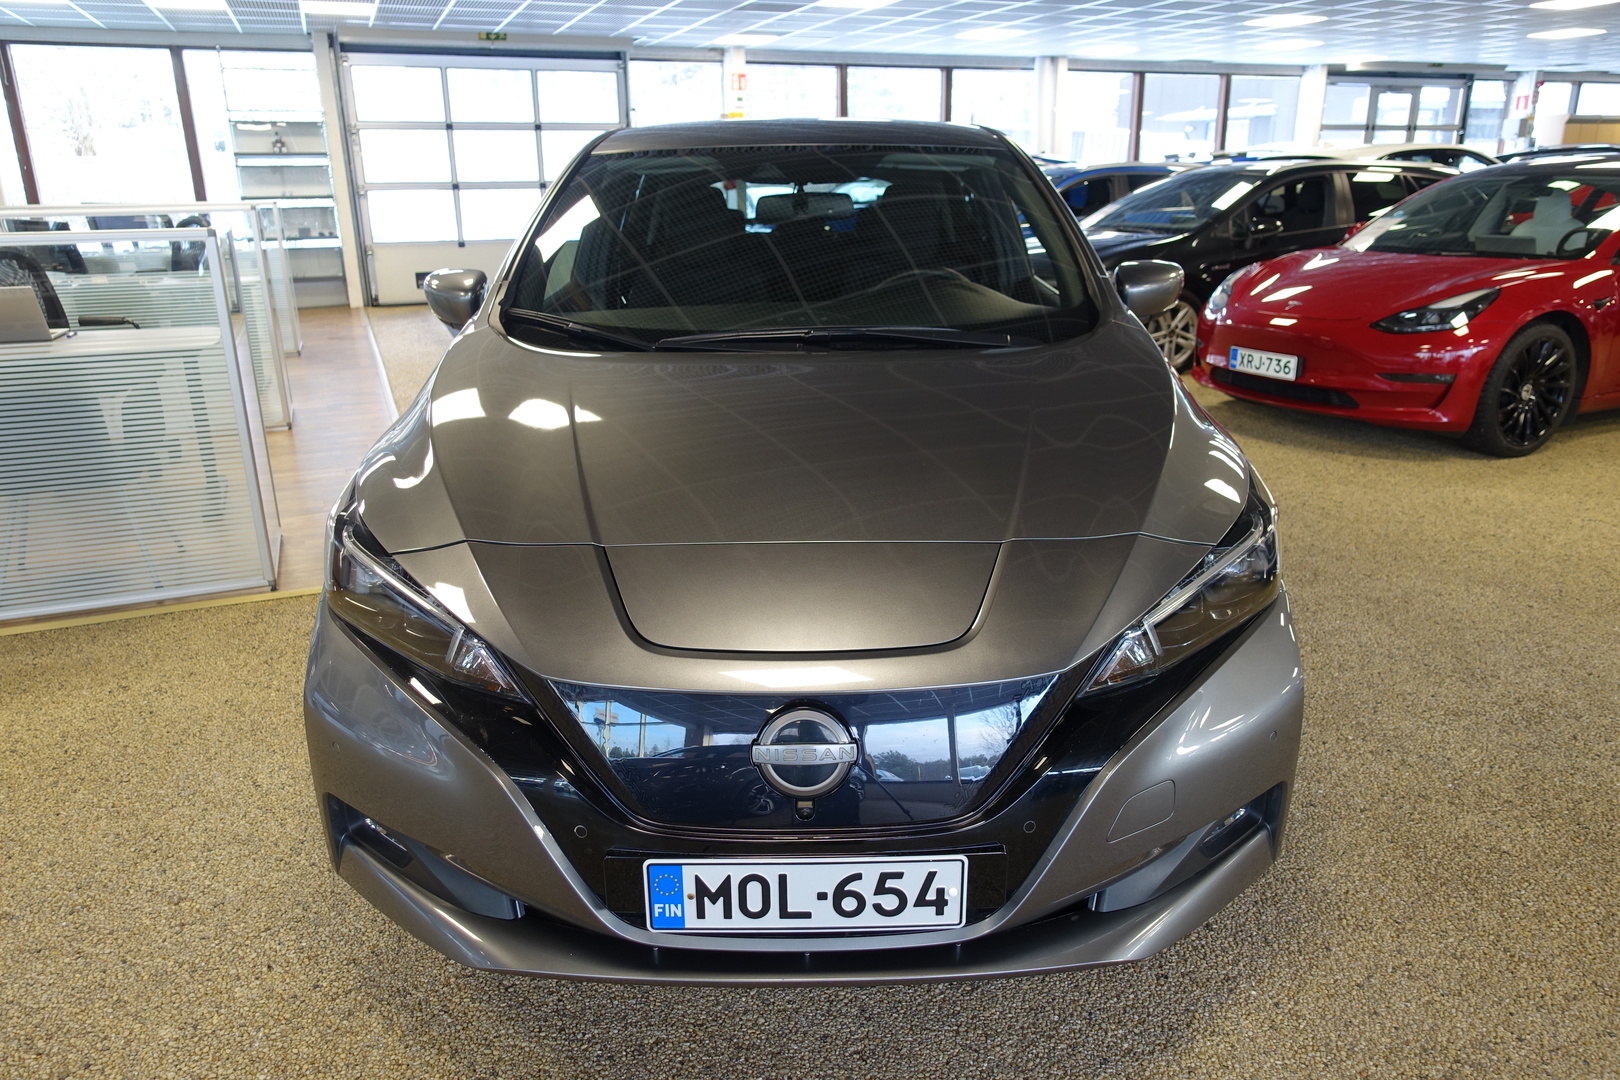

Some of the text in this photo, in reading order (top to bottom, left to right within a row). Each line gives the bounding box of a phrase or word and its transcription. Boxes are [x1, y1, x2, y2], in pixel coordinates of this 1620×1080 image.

[1239, 352, 1292, 375] XRJ-736
[754, 746, 855, 761] NISSAN
[694, 870, 949, 920] MOL-654
[654, 903, 683, 918] FIN
